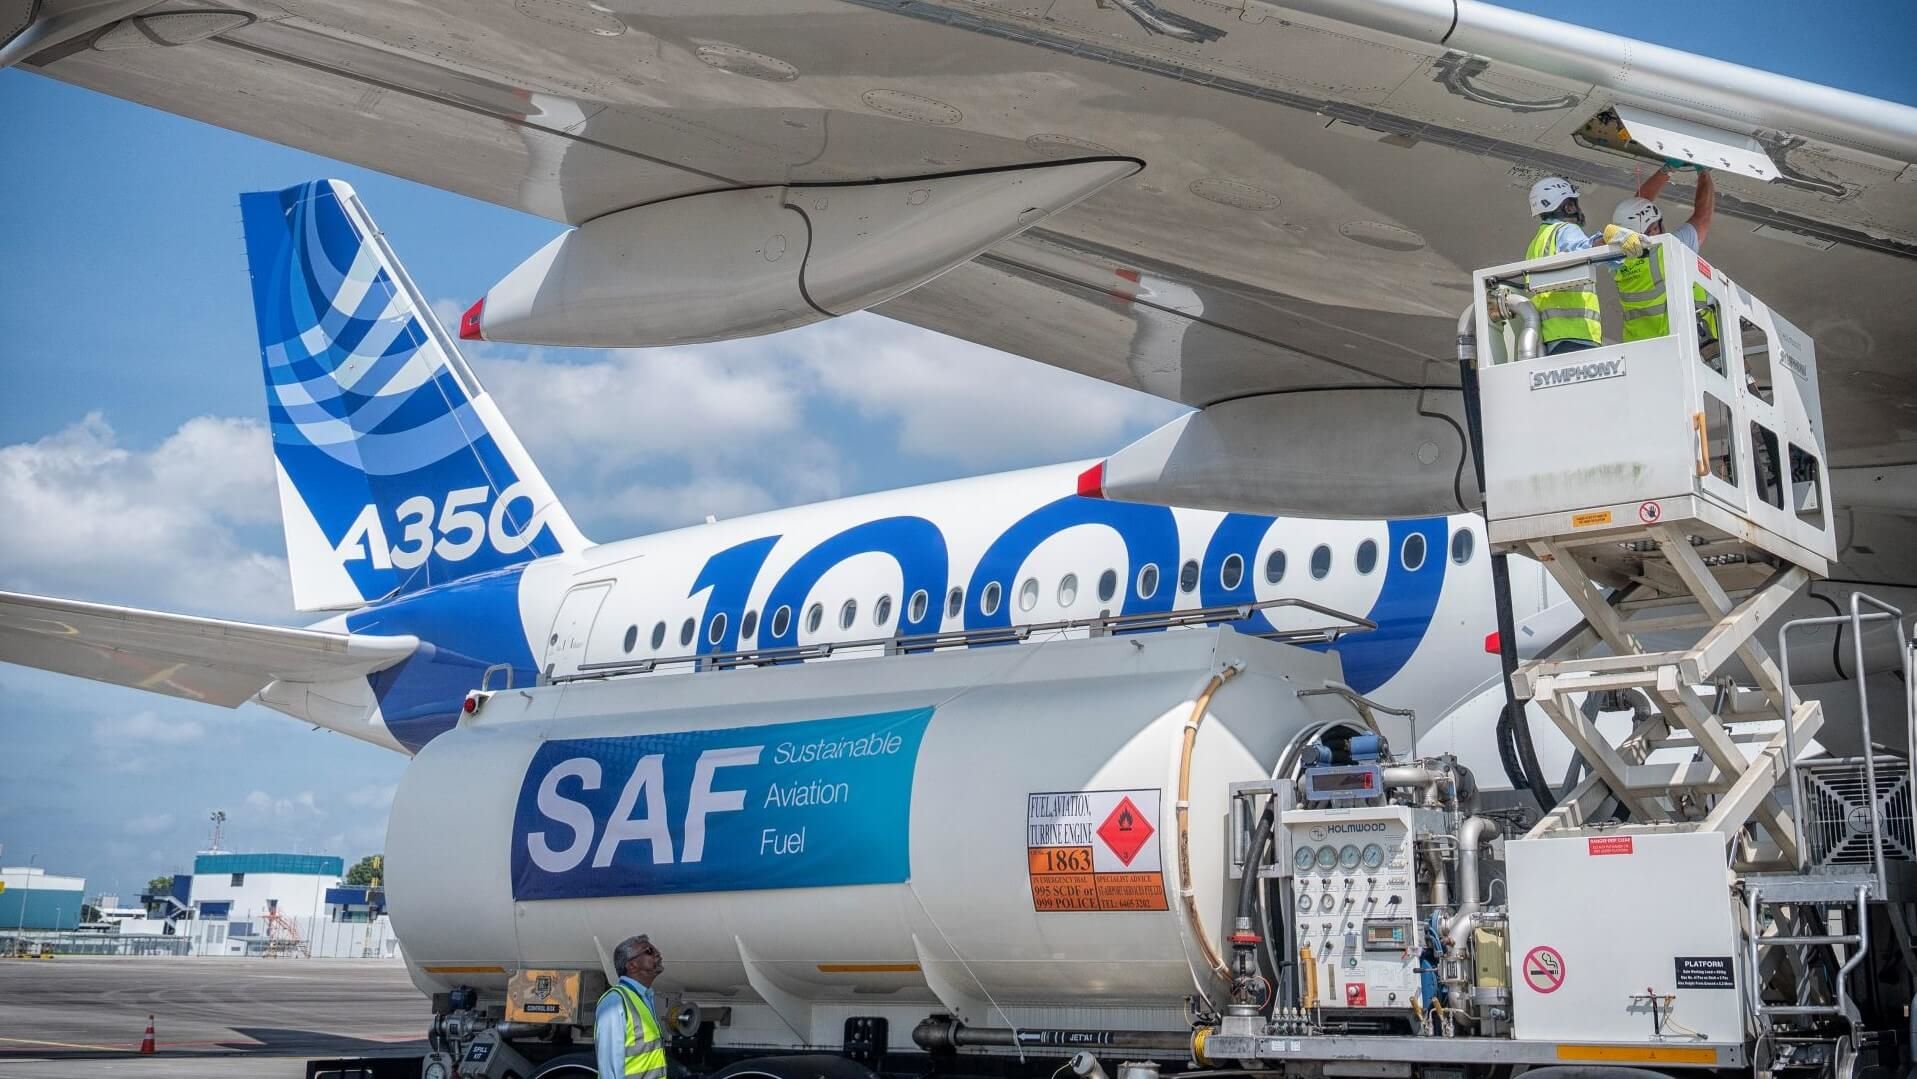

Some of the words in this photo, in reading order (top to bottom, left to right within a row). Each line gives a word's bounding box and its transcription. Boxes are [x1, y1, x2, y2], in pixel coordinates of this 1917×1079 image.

[1533, 360, 1621, 387] SYMPHONY
[336, 480, 545, 570] A350
[689, 494, 1449, 694] 1000
[774, 732, 902, 765] Sustainable
[764, 780, 849, 809] Aviation
[527, 745, 765, 873] SAF
[760, 826, 805, 856] Fuel
[1030, 824, 1062, 844] TURBINE
[1064, 822, 1093, 844] ENGINE
[1328, 822, 1386, 834] HOLMWOOD
[1046, 850, 1090, 871] 1863
[1034, 886, 1051, 896] 995
[1053, 886, 1080, 896] SCDF
[1083, 888, 1095, 896] or
[1036, 898, 1053, 907] 999
[1055, 897, 1098, 908] POLICE
